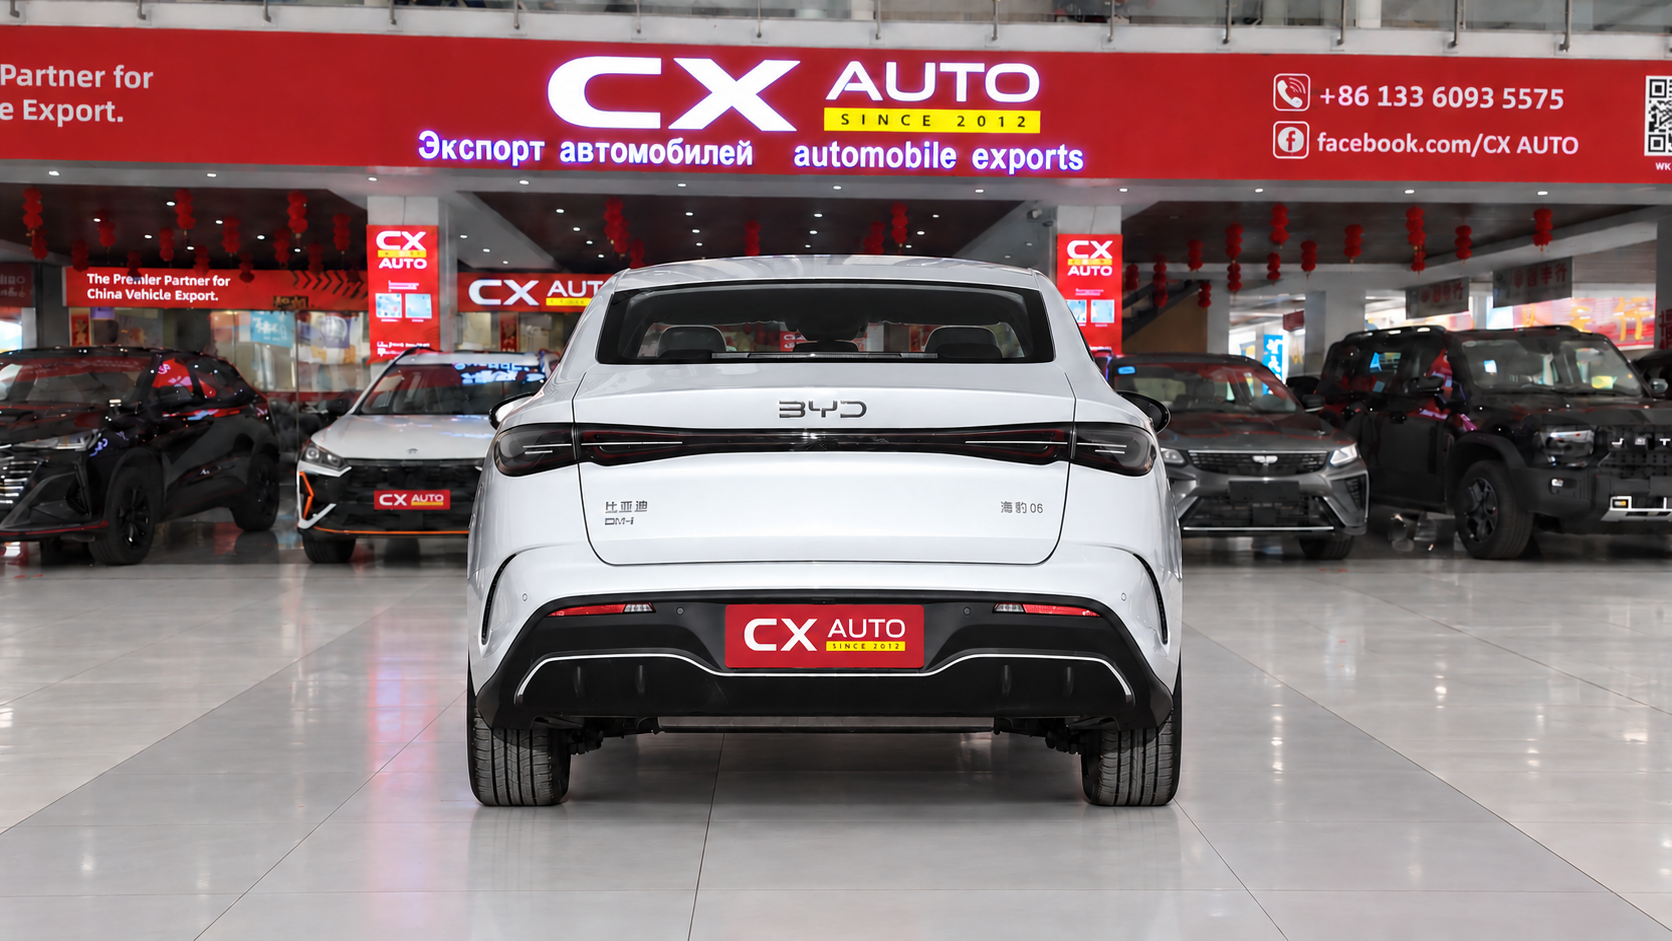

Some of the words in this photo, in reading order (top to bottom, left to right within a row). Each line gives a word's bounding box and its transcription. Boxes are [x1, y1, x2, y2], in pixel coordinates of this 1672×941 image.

[0, 64, 106, 88] Partner
[113, 65, 154, 89] for
[547, 57, 800, 131] CX
[826, 61, 1040, 103] AUTO
[1320, 85, 1370, 107] +86
[1377, 86, 1424, 107] 133
[1432, 87, 1494, 109] 6093
[1502, 88, 1564, 110] 5575
[23, 100, 124, 127] Export.
[841, 112, 932, 127] SINCE
[957, 113, 1029, 128] 2012
[418, 130, 546, 167] Экспорт
[559, 136, 755, 167] автомобилей
[1317, 132, 1511, 157] facebook.com/CX
[1516, 135, 1579, 154] AUTO
[794, 141, 957, 170] automobile
[972, 145, 1085, 175] exports
[376, 230, 427, 251] CX
[1066, 239, 1113, 259] CX
[378, 257, 427, 269] AUTO
[1067, 265, 1112, 277] AUTO
[87, 273, 110, 285] The
[164, 275, 210, 287] Partner
[212, 275, 231, 287] for
[86, 288, 123, 300] China
[125, 289, 172, 301] Vehicle
[174, 290, 219, 304] Export.
[468, 279, 540, 306] CX
[547, 280, 604, 297] AUT
[779, 401, 867, 418] BYD
[379, 494, 407, 506] CX
[411, 494, 444, 502] AUTO
[605, 500, 647, 513] 比亚迪
[743, 618, 818, 652] CX
[827, 618, 906, 638] AUTO
